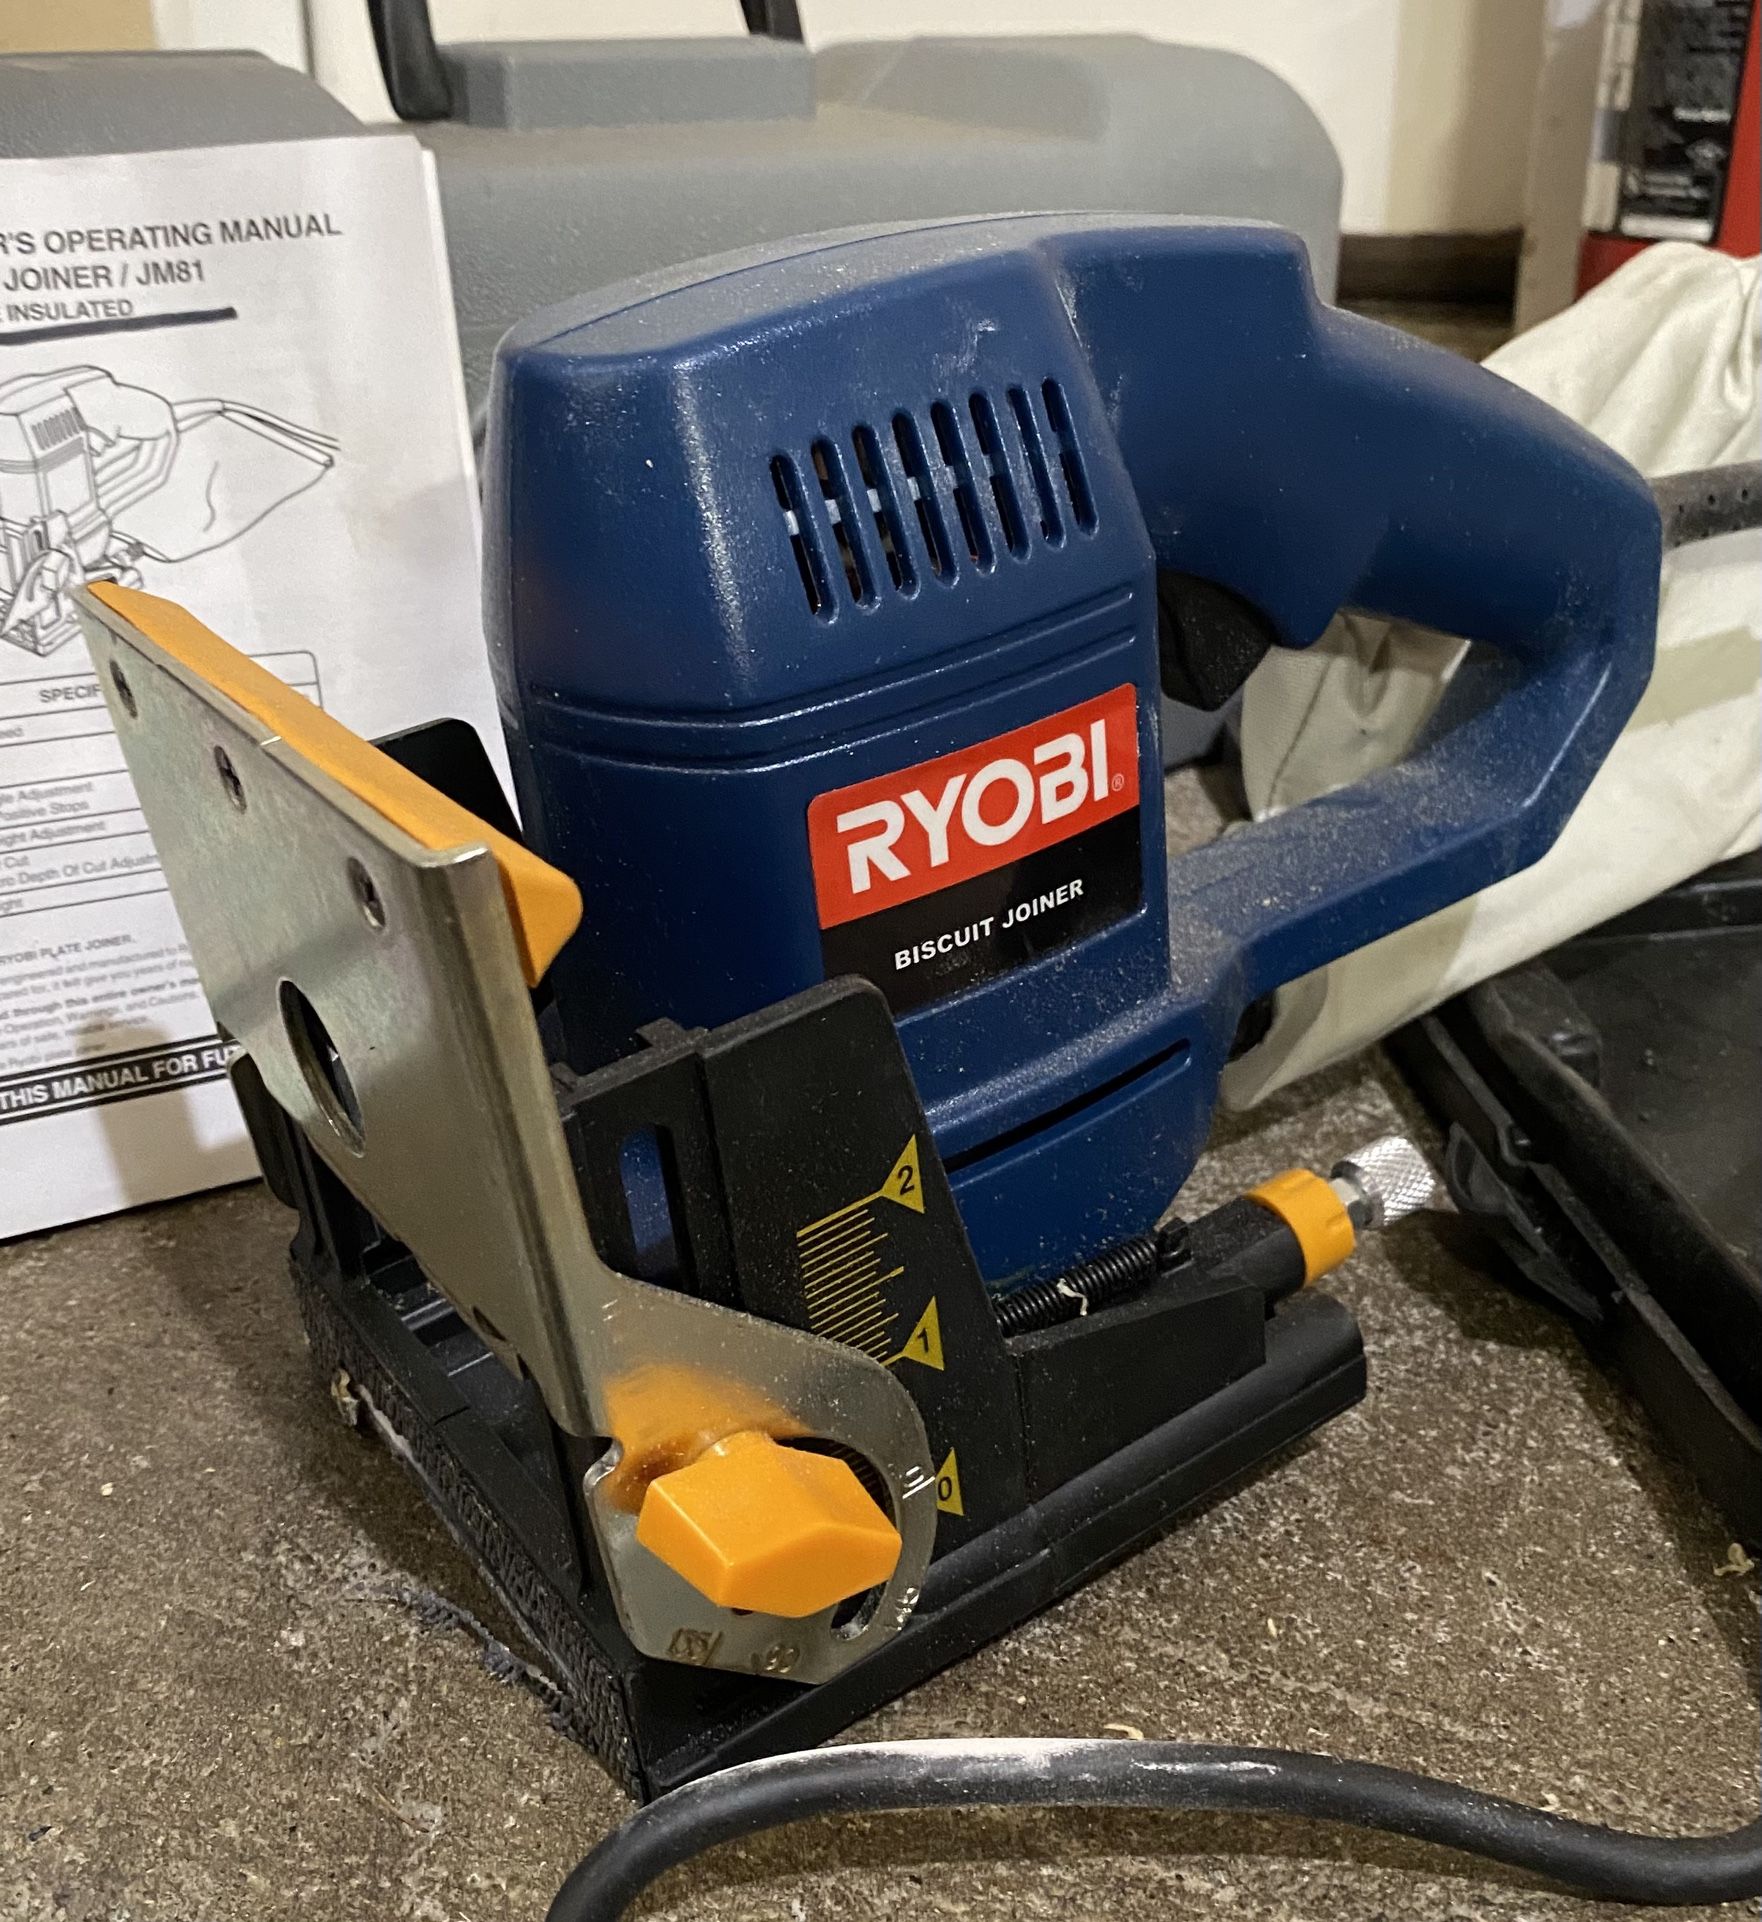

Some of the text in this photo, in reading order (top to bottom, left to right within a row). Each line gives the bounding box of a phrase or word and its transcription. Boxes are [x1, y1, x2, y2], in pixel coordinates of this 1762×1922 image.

[43, 221, 214, 254] OPERATING
[219, 212, 344, 244] MANUAL
[3, 264, 114, 291] JOINER
[135, 258, 205, 286] JM81
[6, 298, 134, 322] INSULATED
[836, 718, 1109, 894] RYOBI
[894, 879, 1084, 970] BISCUIT JOINER
[0, 1084, 49, 1110] THIS
[52, 1065, 149, 1100] MANUAL
[153, 1053, 198, 1079] FOR
[898, 1164, 915, 1195] 2
[917, 1327, 929, 1353] 1
[938, 1476, 952, 1501] 0
